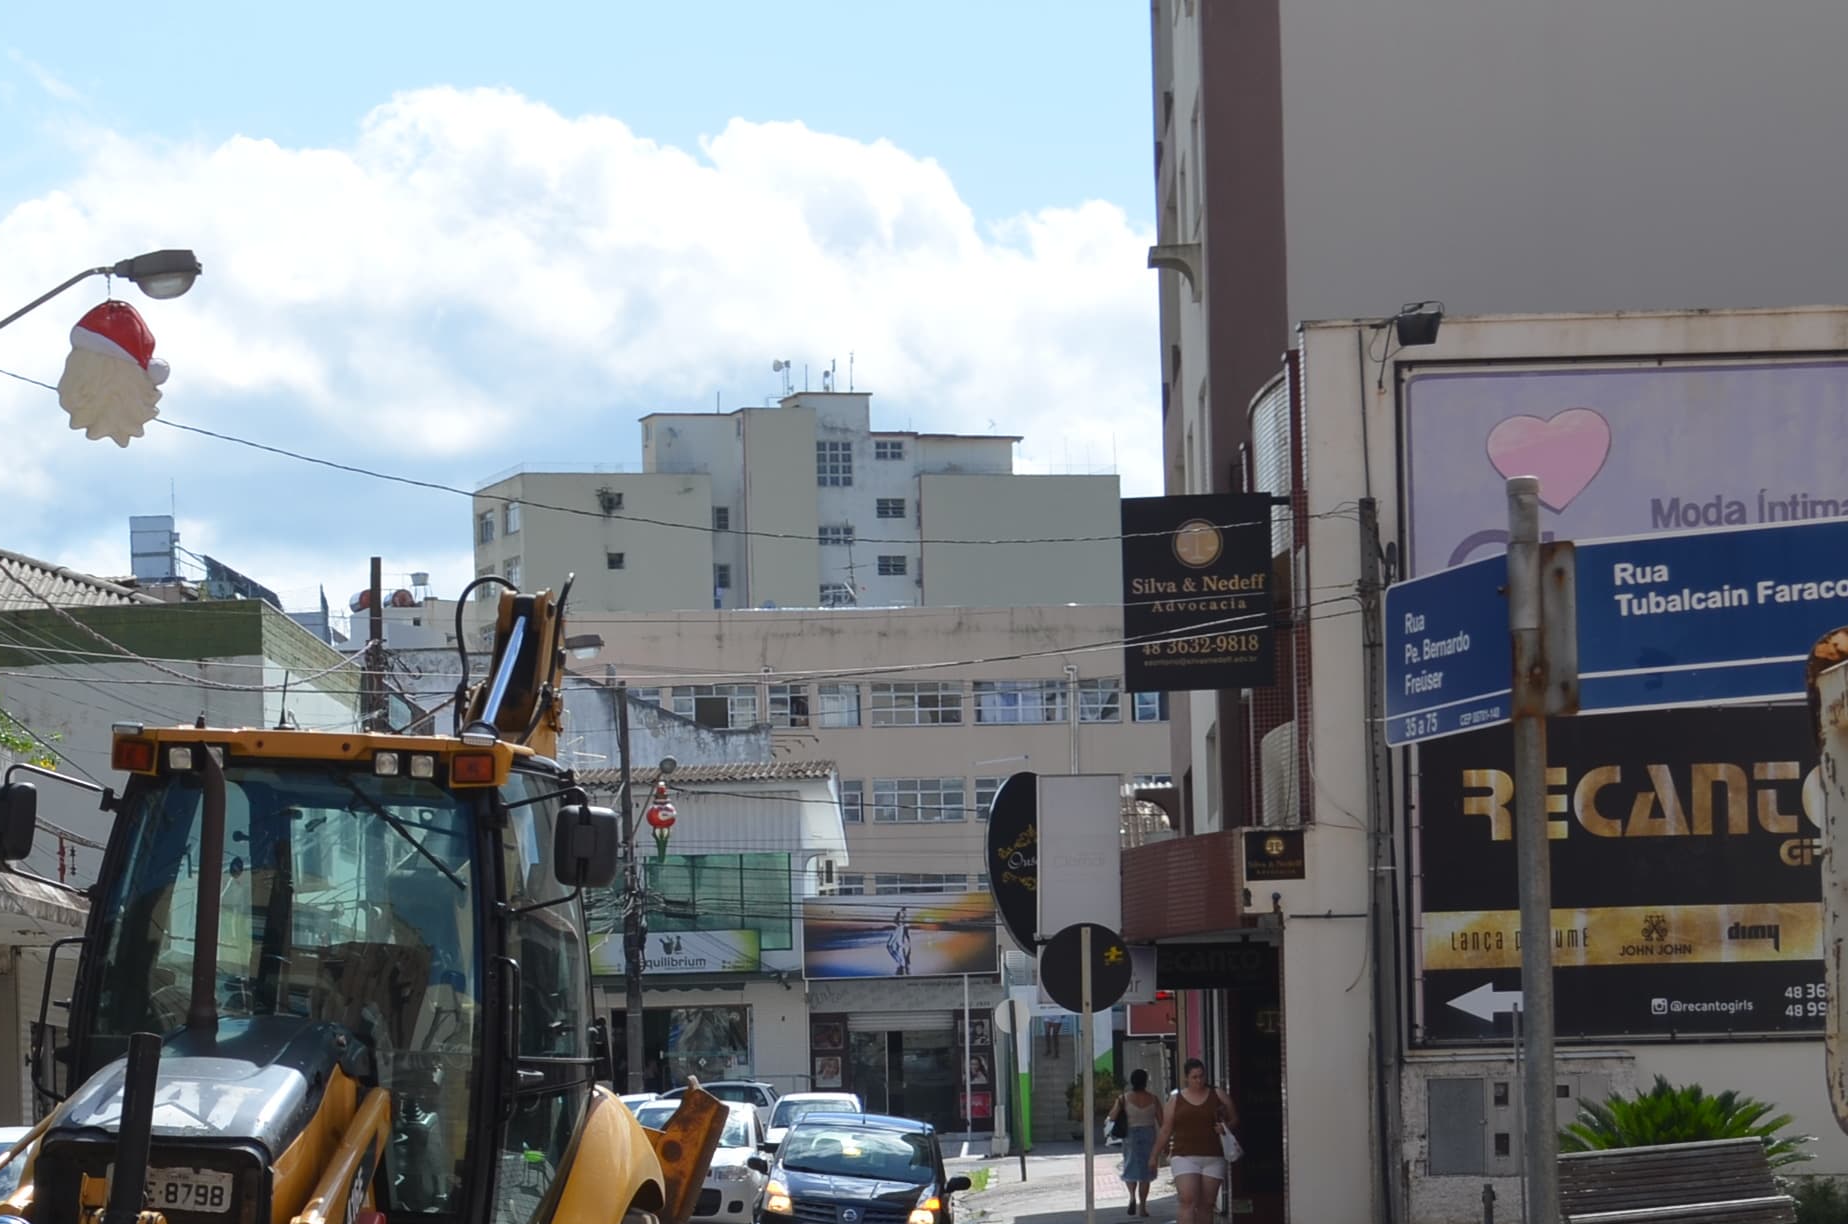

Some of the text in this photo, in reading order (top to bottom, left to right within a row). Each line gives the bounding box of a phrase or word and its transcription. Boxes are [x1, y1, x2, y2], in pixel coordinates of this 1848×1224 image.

[1651, 495, 1747, 529] Moda
[1131, 573, 1266, 594] Silva & Nedeff
[1614, 562, 1669, 586] Rua
[1151, 597, 1248, 613] Advocacia
[1614, 579, 1848, 617] Tubalcain Faraco
[1404, 612, 1425, 635] Rua
[1166, 634, 1259, 654] 3632-9818
[1404, 630, 1470, 665] Pe. Bernardo
[1404, 670, 1444, 696] Freüser
[1405, 712, 1438, 738] 35 a 75
[1619, 942, 1692, 957] JOHN JOHN
[1784, 983, 1826, 999] 48 36
[1670, 1000, 1754, 1015] @recantogirls
[1784, 1002, 1827, 1017] 48 99
